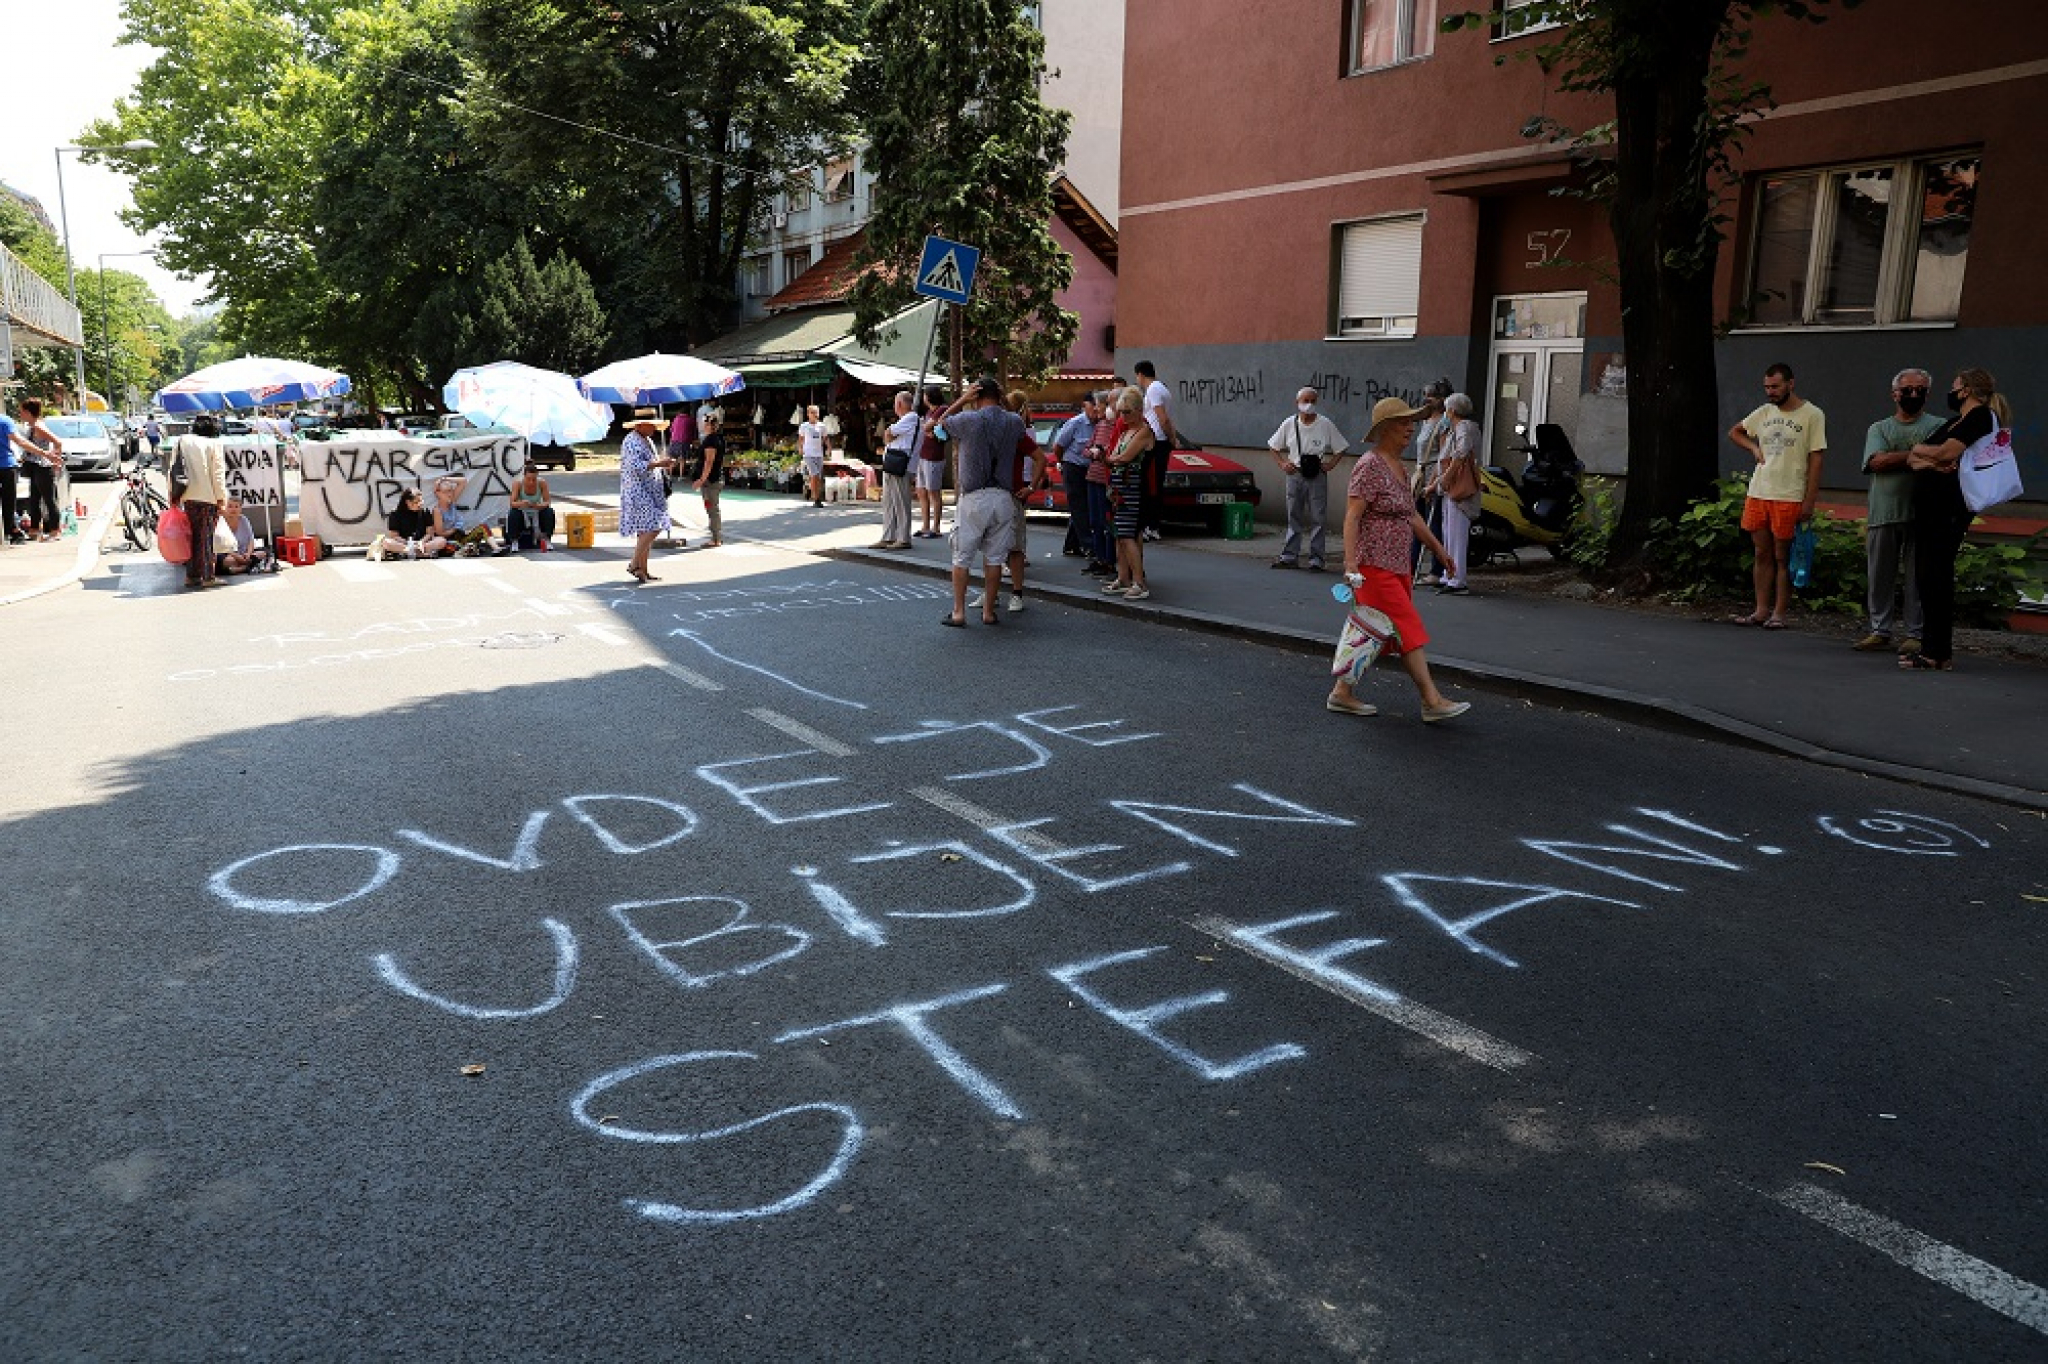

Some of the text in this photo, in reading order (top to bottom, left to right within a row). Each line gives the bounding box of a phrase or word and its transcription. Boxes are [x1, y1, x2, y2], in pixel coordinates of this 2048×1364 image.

[1179, 369, 1265, 406] ПАРТИЗАН!
[301, 448, 417, 484] LAZAR
[208, 704, 1165, 915] OVDE JE
[570, 806, 1790, 1224] STEFAN!
